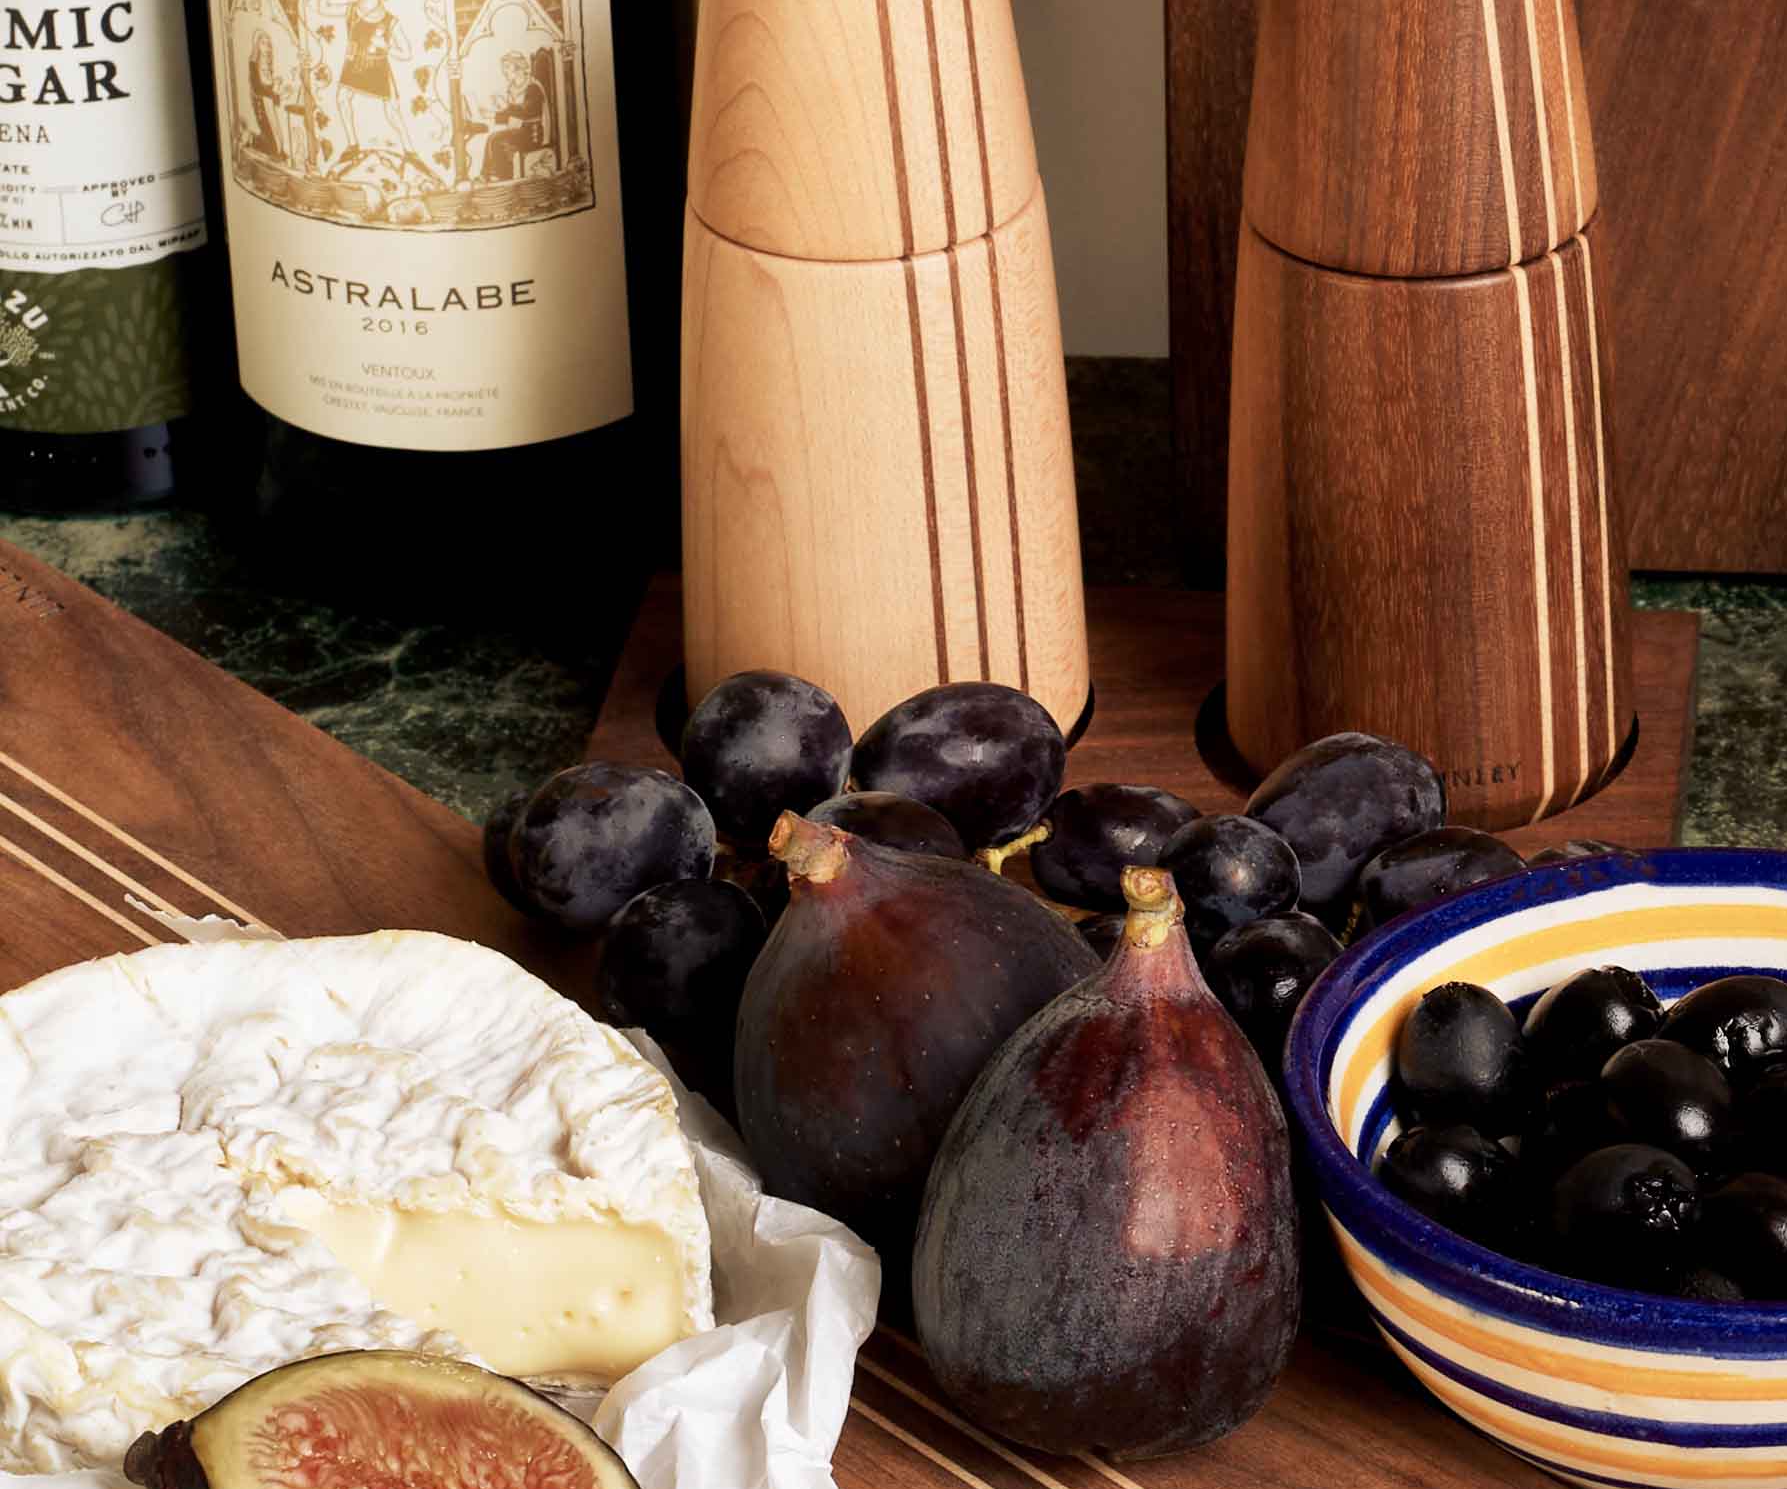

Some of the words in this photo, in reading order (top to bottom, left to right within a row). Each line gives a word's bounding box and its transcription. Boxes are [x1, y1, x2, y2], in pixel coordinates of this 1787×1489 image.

[4, 0, 134, 50] MIC
[0, 60, 130, 105] GAR
[0, 123, 50, 143] ENA
[0, 163, 31, 175] ATE
[83, 175, 155, 192] APPROVED
[271, 260, 537, 312] ASTRALABE
[0, 289, 48, 330] ZU
[361, 316, 430, 336] 2016
[361, 362, 436, 382] VENTOUX
